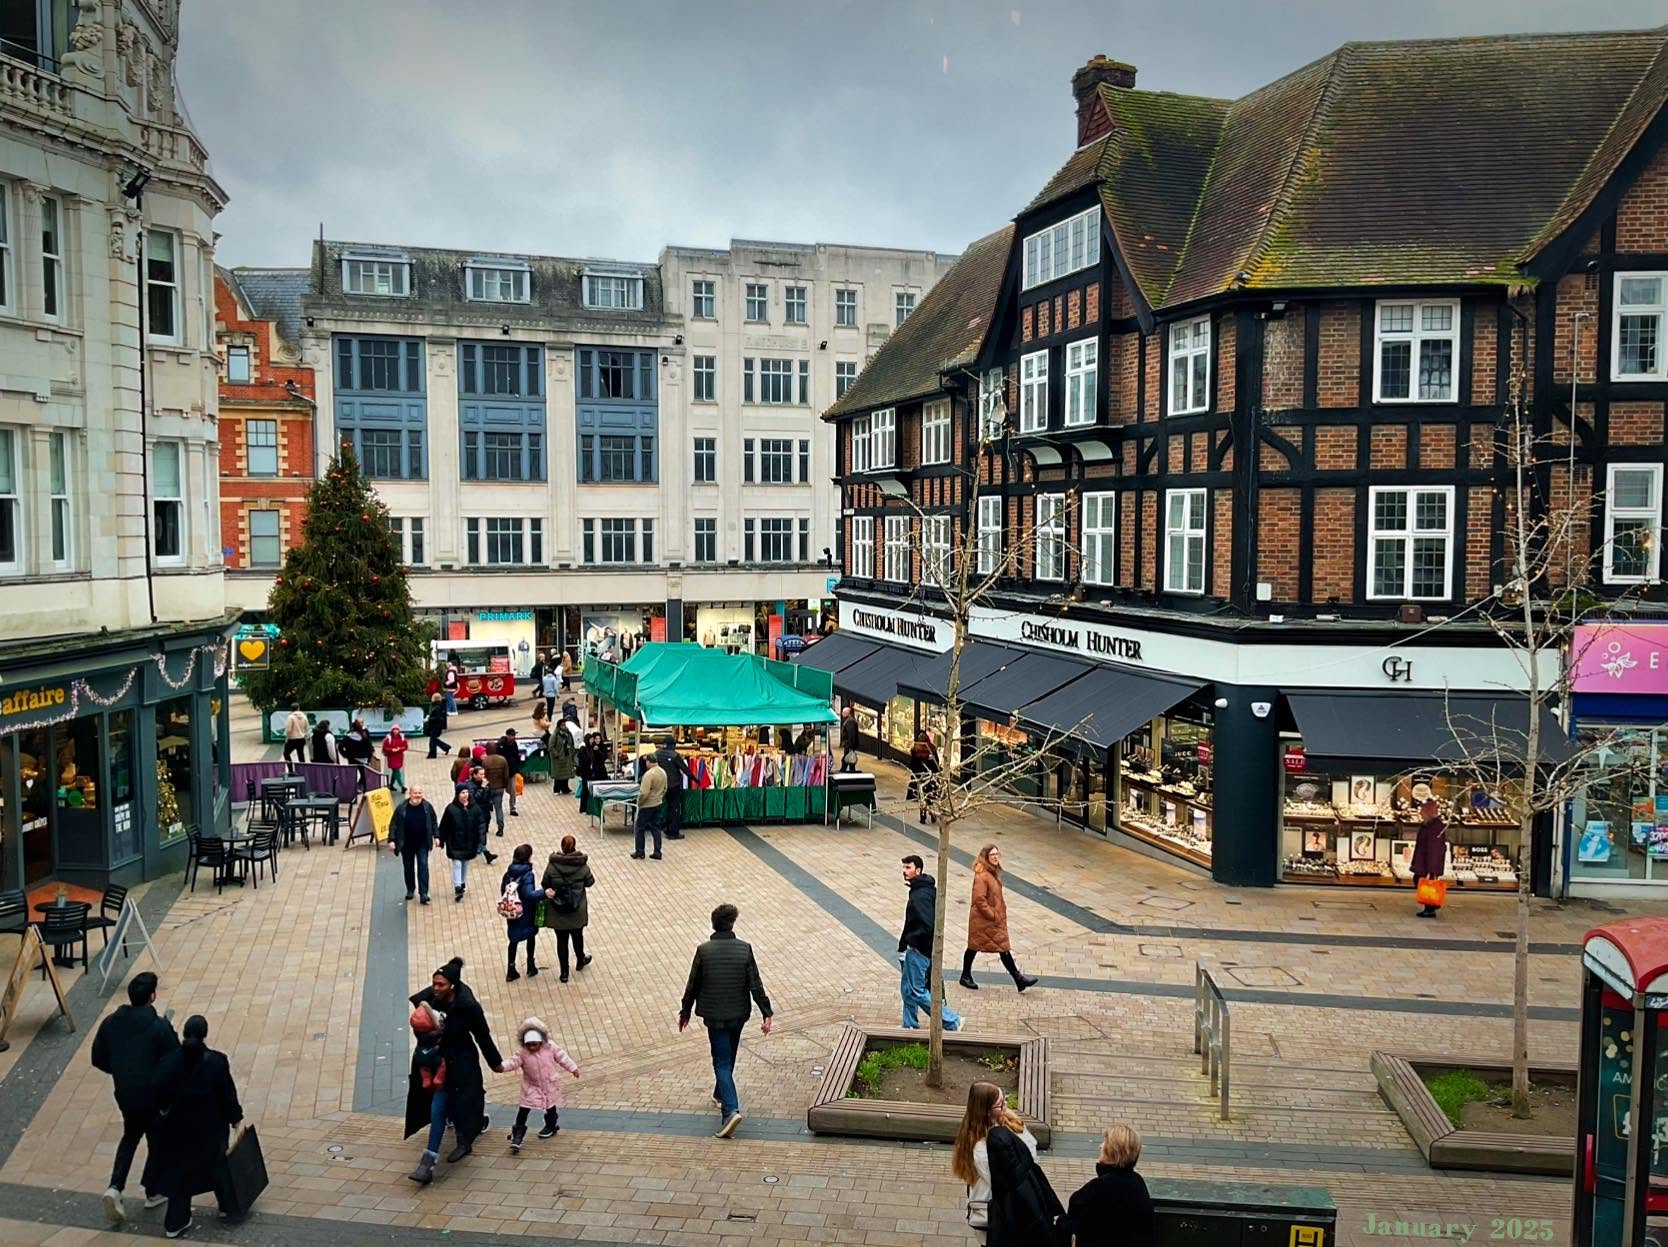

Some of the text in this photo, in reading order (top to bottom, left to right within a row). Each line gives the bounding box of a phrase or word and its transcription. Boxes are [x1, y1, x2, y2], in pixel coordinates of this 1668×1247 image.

[479, 611, 533, 621] PRIMARK
[1021, 620, 1143, 660] CHISHOLM HUNTER
